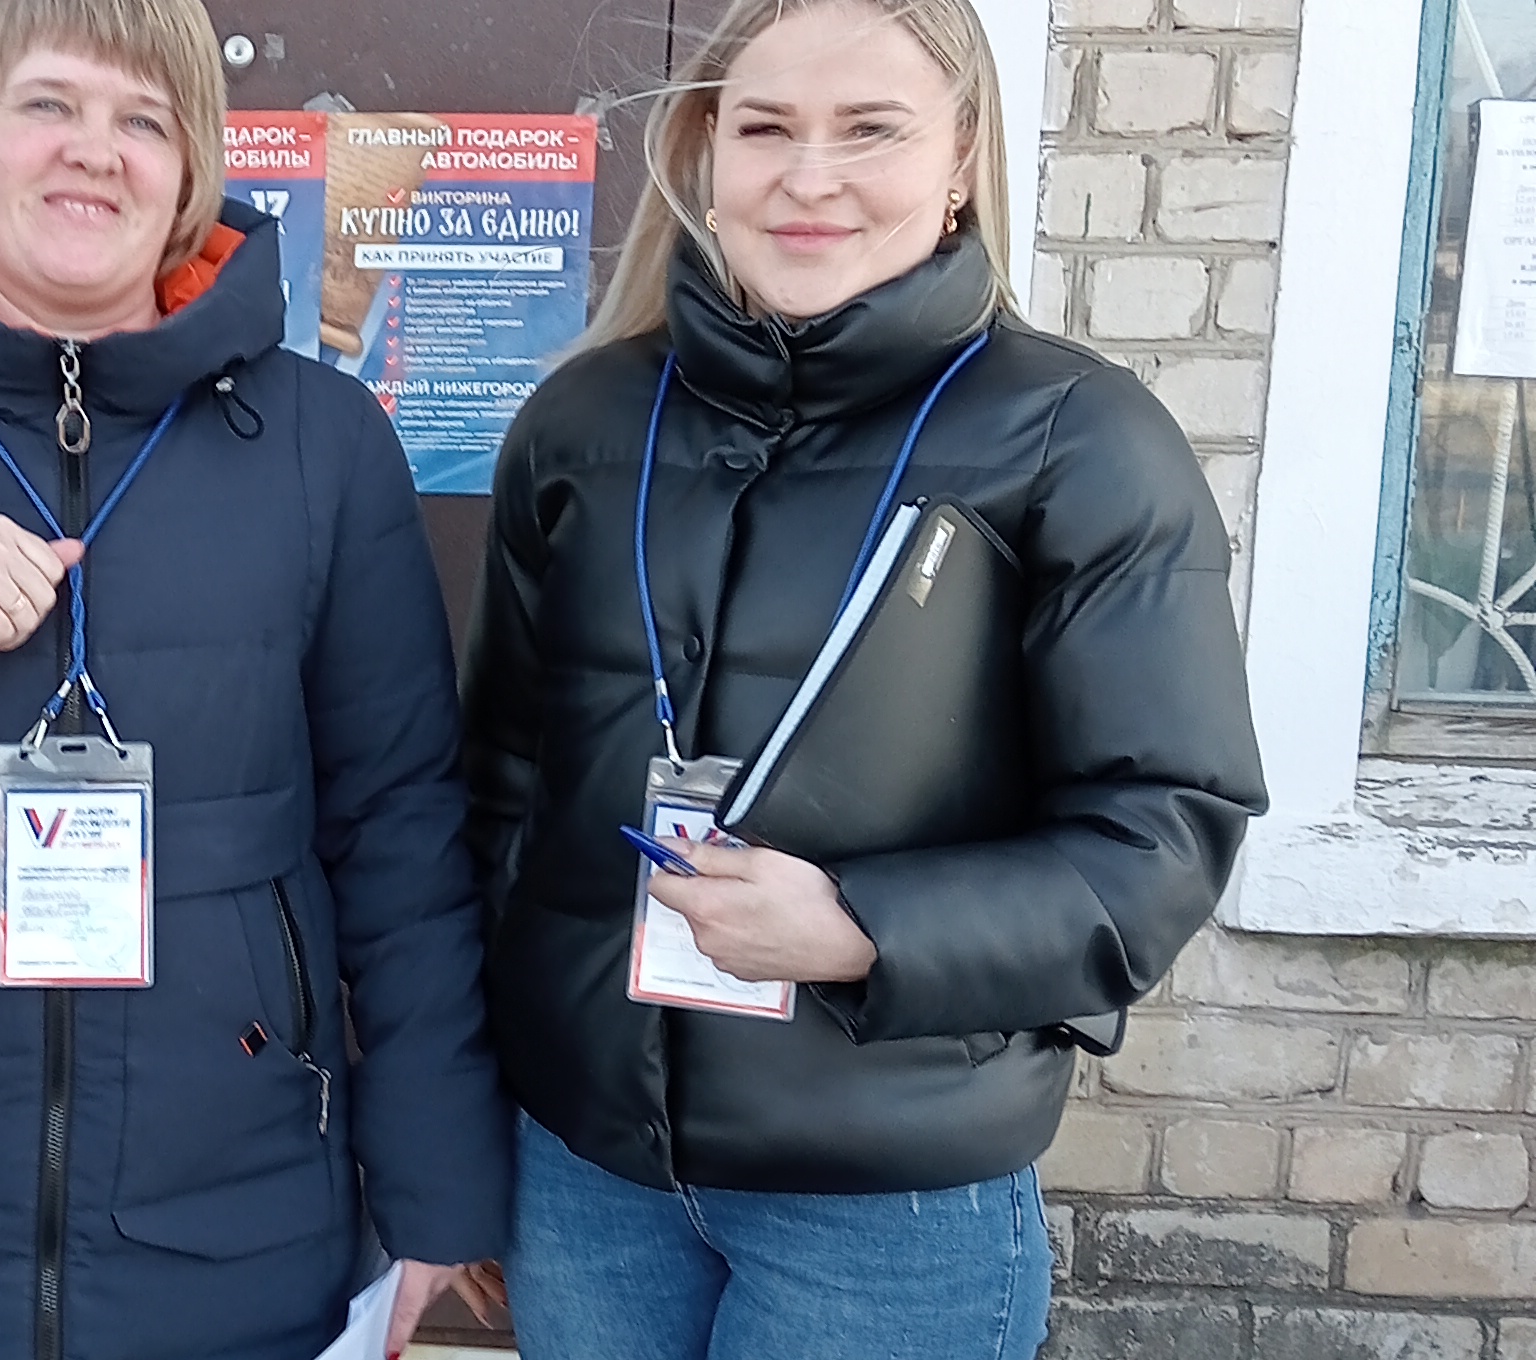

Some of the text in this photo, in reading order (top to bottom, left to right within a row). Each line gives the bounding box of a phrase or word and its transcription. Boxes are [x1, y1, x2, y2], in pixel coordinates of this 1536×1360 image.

[348, 125, 452, 147] ГЛАВНЫЙ
[457, 129, 565, 150] ПОДАРОК
[420, 151, 579, 171] АВТОМОБИЛЬ!
[410, 190, 513, 206] ВИКТОРИНА
[340, 207, 431, 237] КУПНО
[437, 207, 474, 238] ЗА
[361, 250, 553, 266] КАК ПРИНЯТЬ УЧАСТИЕ
